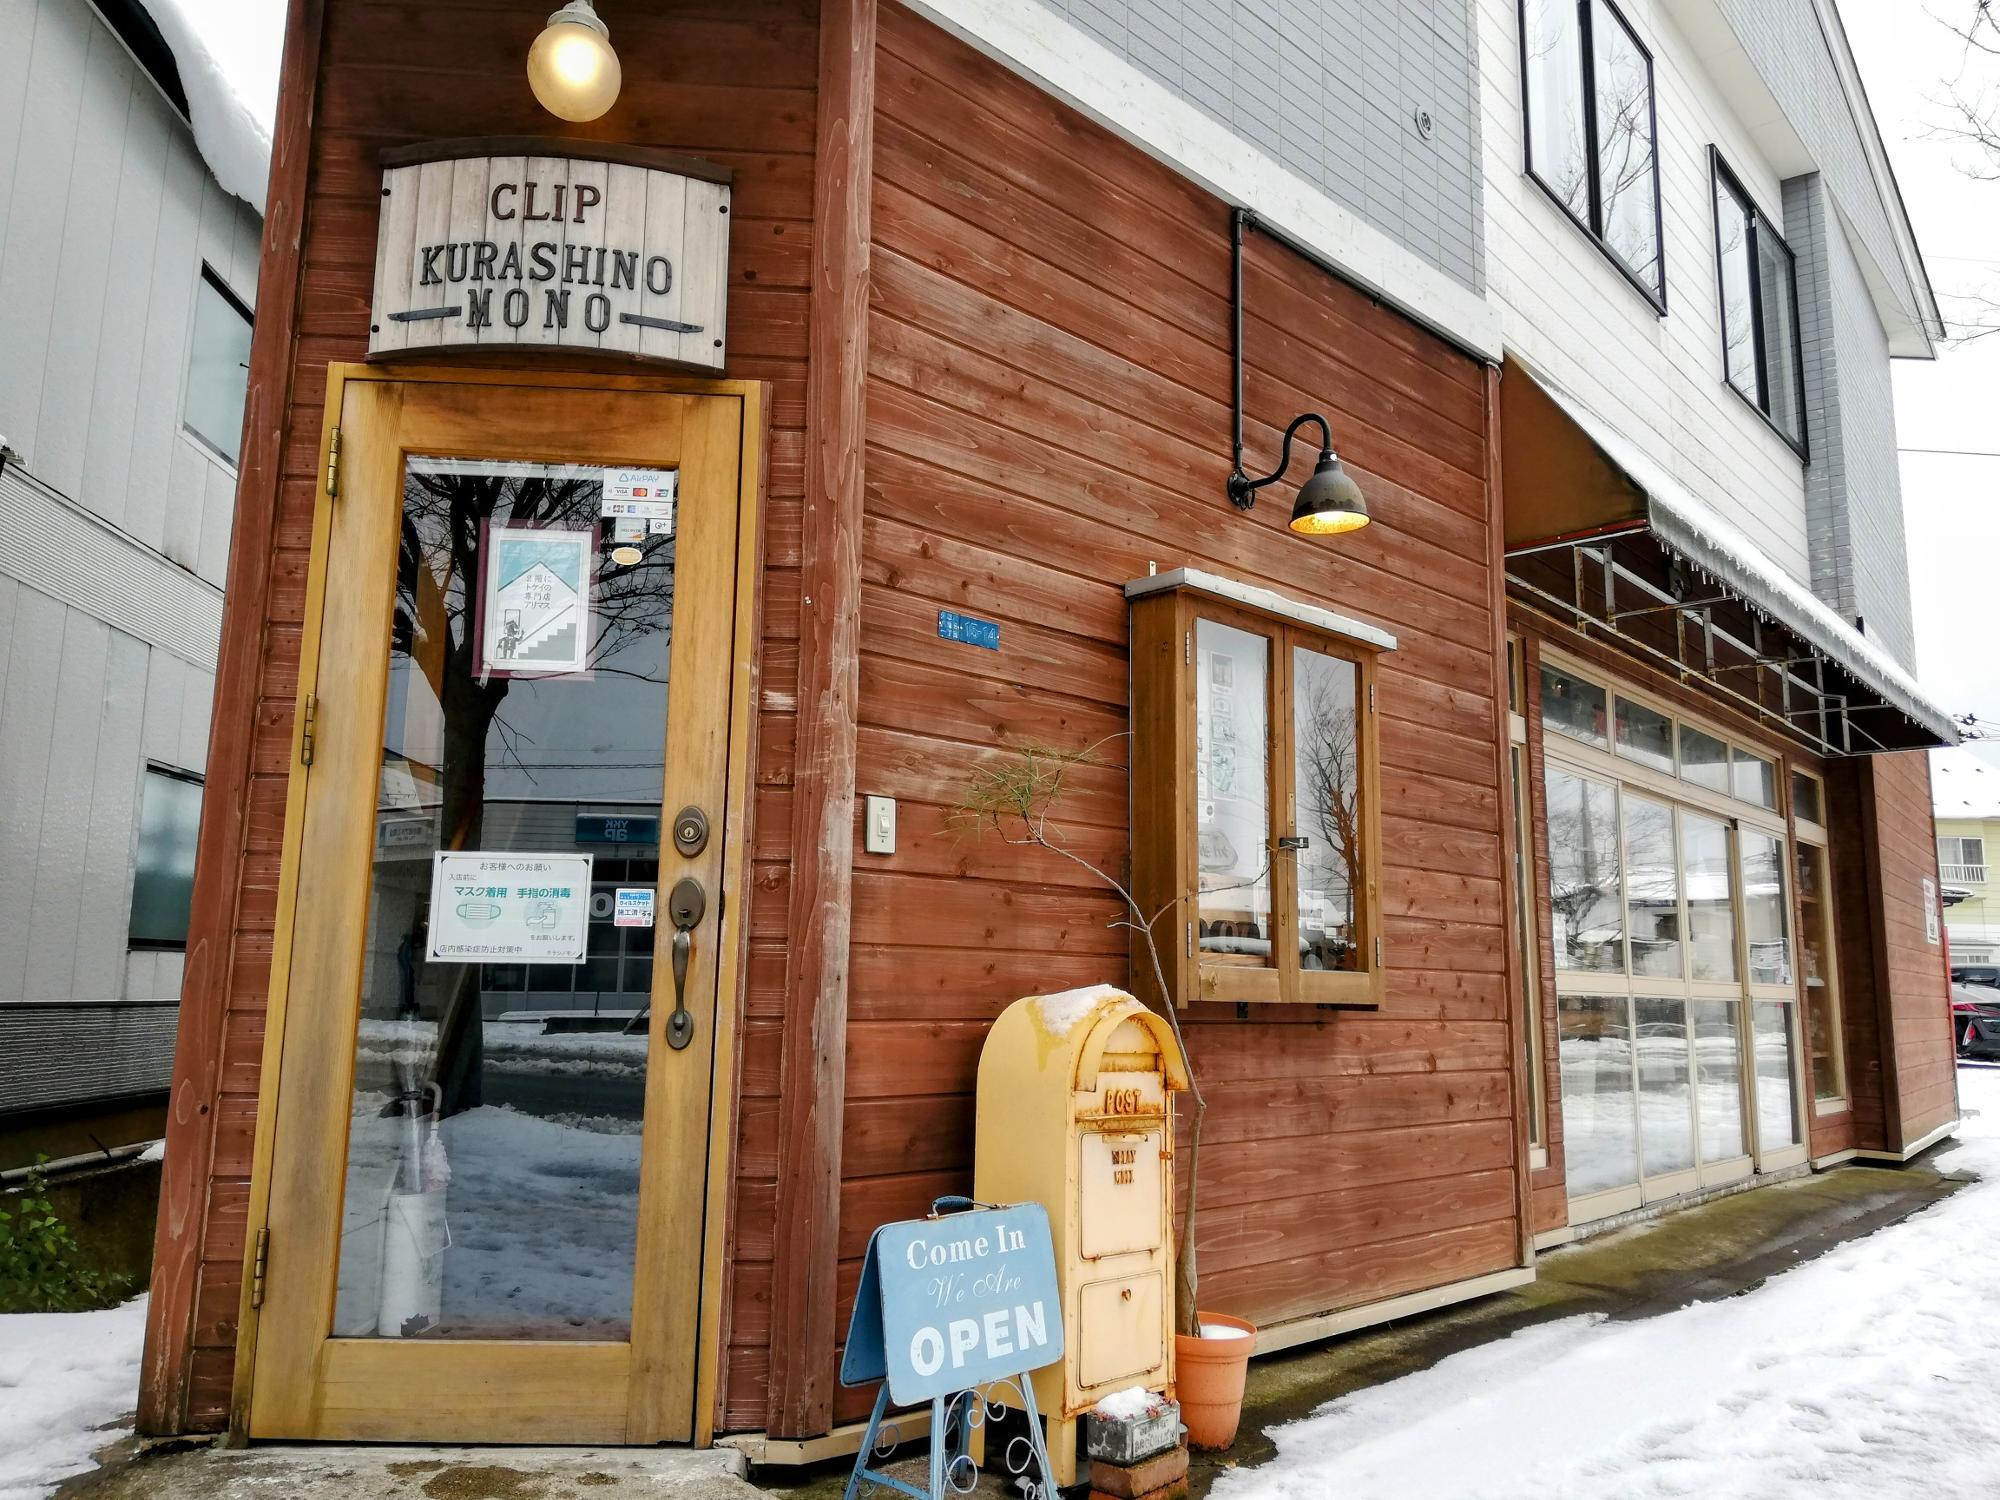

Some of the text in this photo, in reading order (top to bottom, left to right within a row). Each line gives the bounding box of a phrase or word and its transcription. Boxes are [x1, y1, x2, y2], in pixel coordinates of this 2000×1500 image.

[491, 182, 601, 223] CLIP
[419, 241, 672, 295] KURASHINO
[466, 288, 611, 333] MONO
[448, 873, 477, 881] 入店前に
[480, 862, 552, 872] お客様へのお願い
[454, 886, 571, 899] マスク着用 手指の消毒
[439, 945, 523, 954] 店内感染症防止対策中
[530, 934, 576, 942] をお願いします。
[1104, 1088, 1142, 1115] POST
[906, 1224, 1026, 1270] Come In
[928, 1263, 1022, 1309] We Are
[910, 1301, 1048, 1376] OPEN
